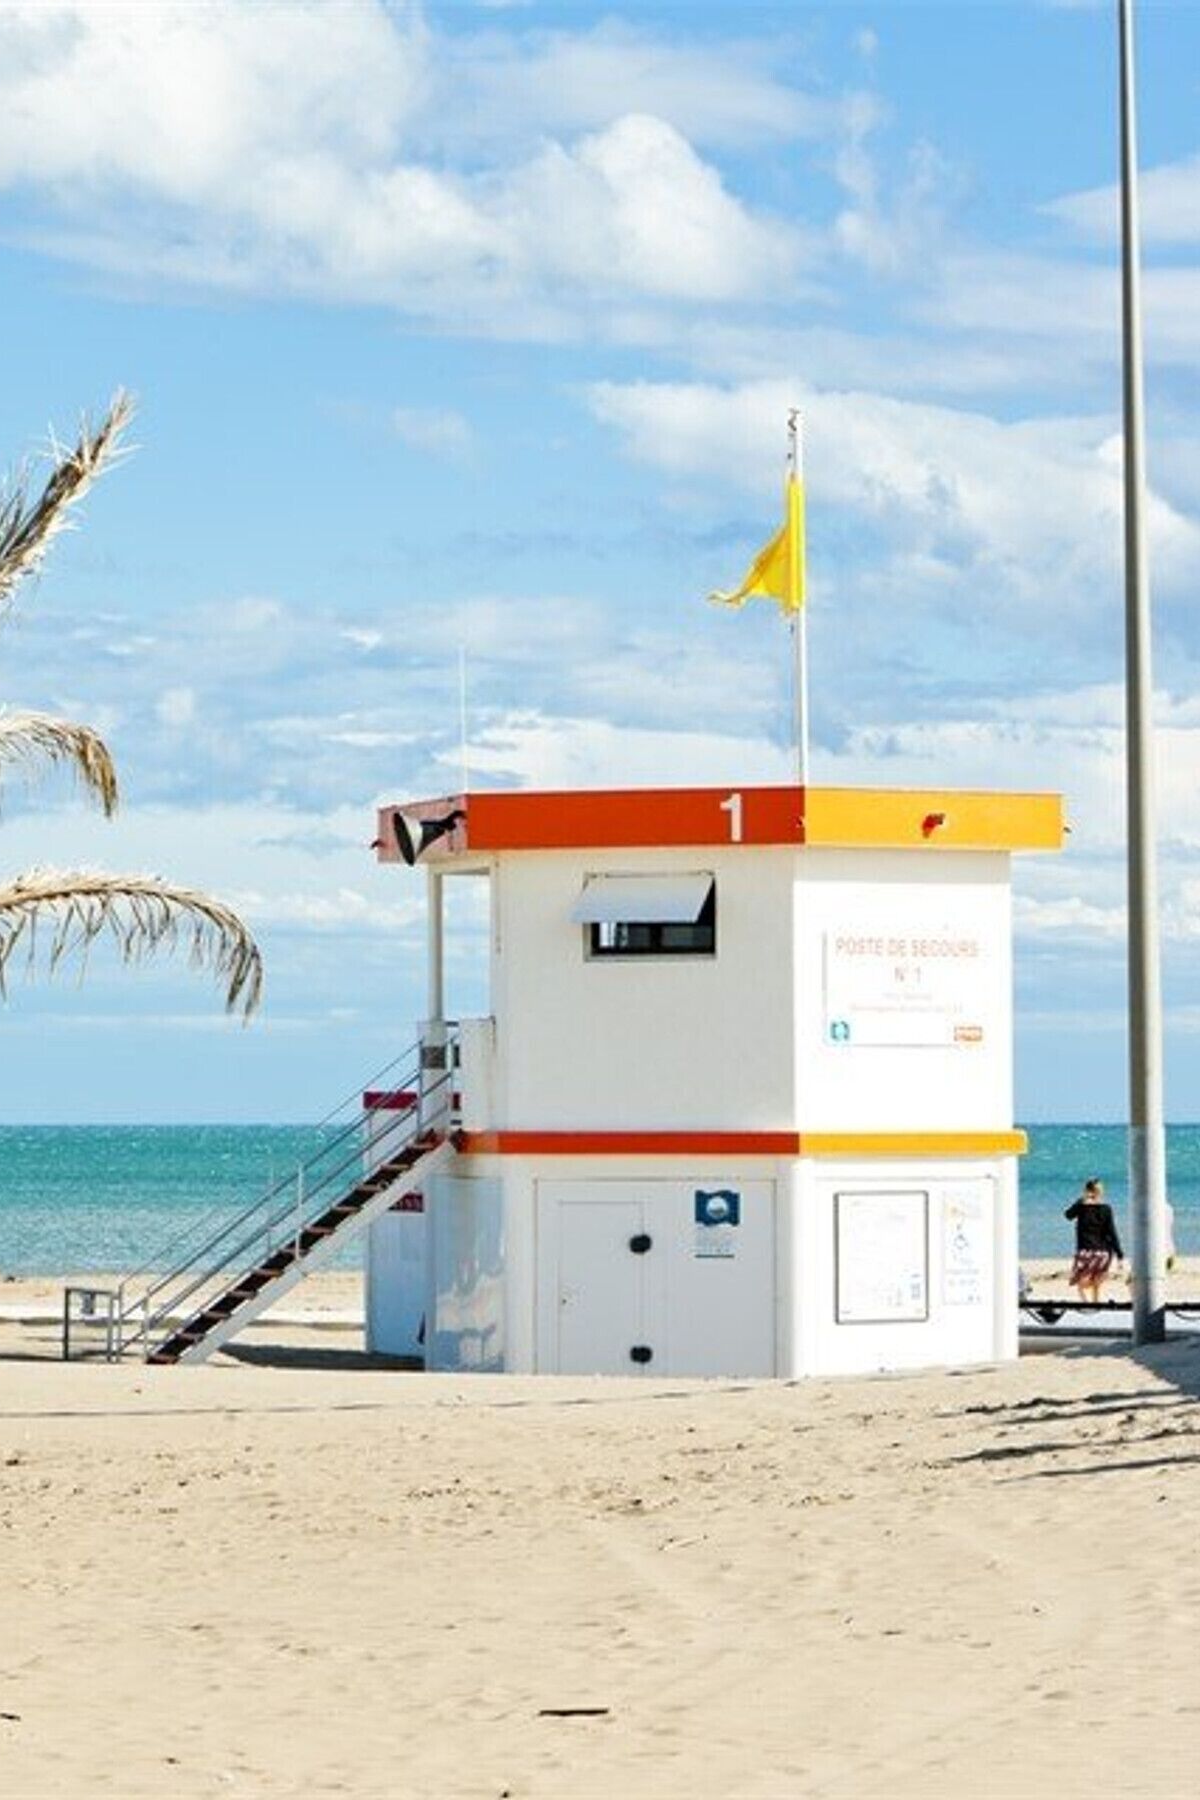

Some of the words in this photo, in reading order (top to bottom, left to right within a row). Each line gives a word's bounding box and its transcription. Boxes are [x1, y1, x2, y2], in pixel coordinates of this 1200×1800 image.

[720, 793, 741, 842] 1
[835, 936, 883, 956] POSTE
[887, 937, 907, 957] DE
[911, 938, 978, 957] SECOURS
